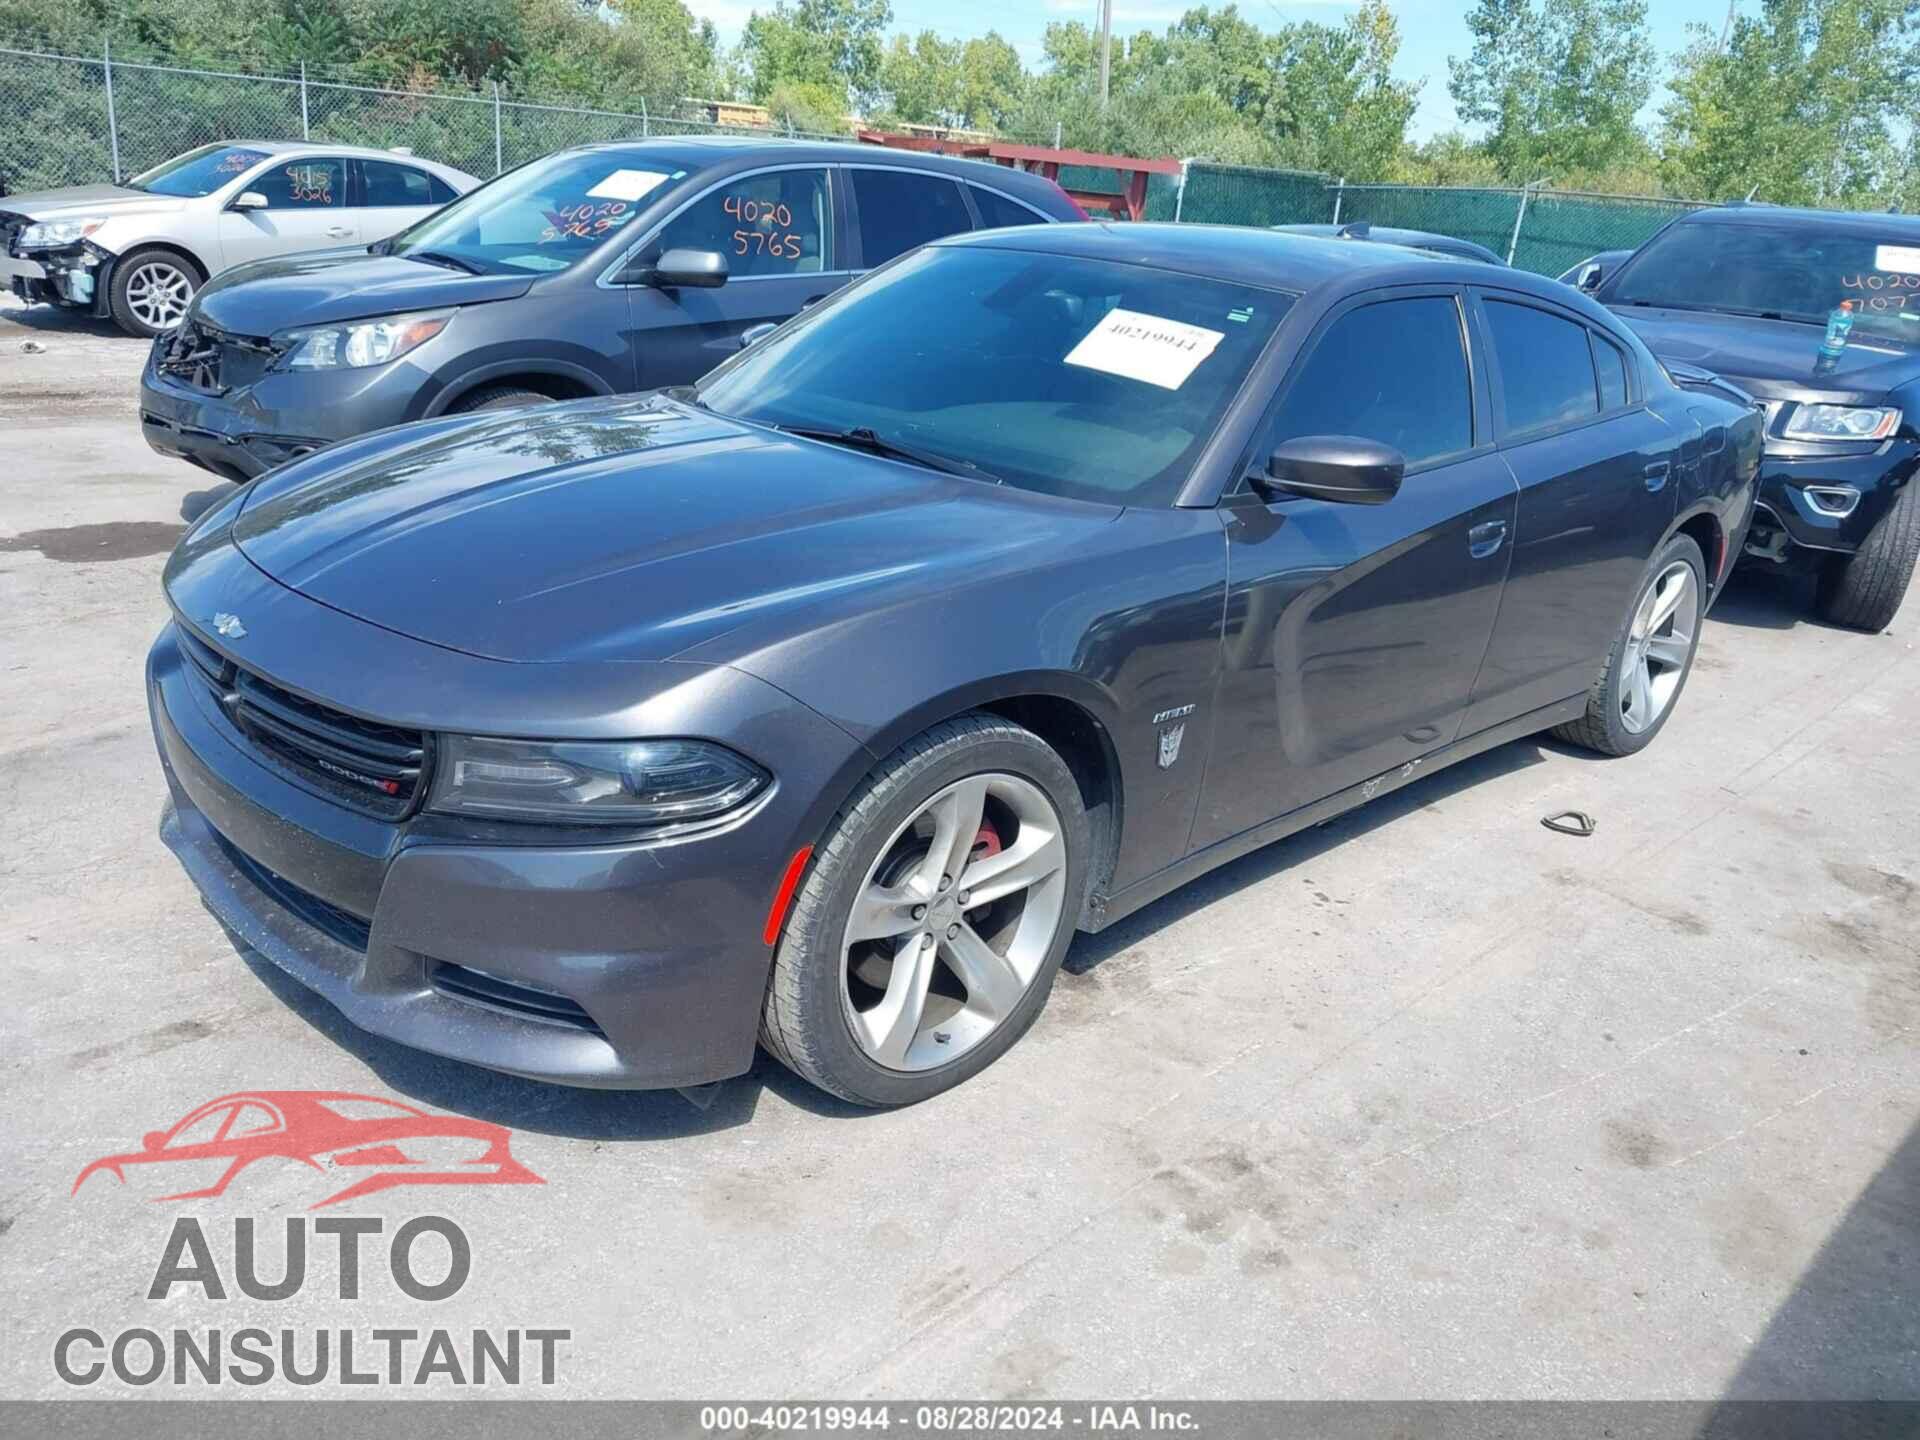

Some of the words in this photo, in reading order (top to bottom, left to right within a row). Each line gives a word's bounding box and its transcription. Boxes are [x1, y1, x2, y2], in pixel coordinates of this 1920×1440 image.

[723, 196, 792, 227] 4020
[734, 231, 801, 259] 5765
[1842, 274, 1920, 290] 4020
